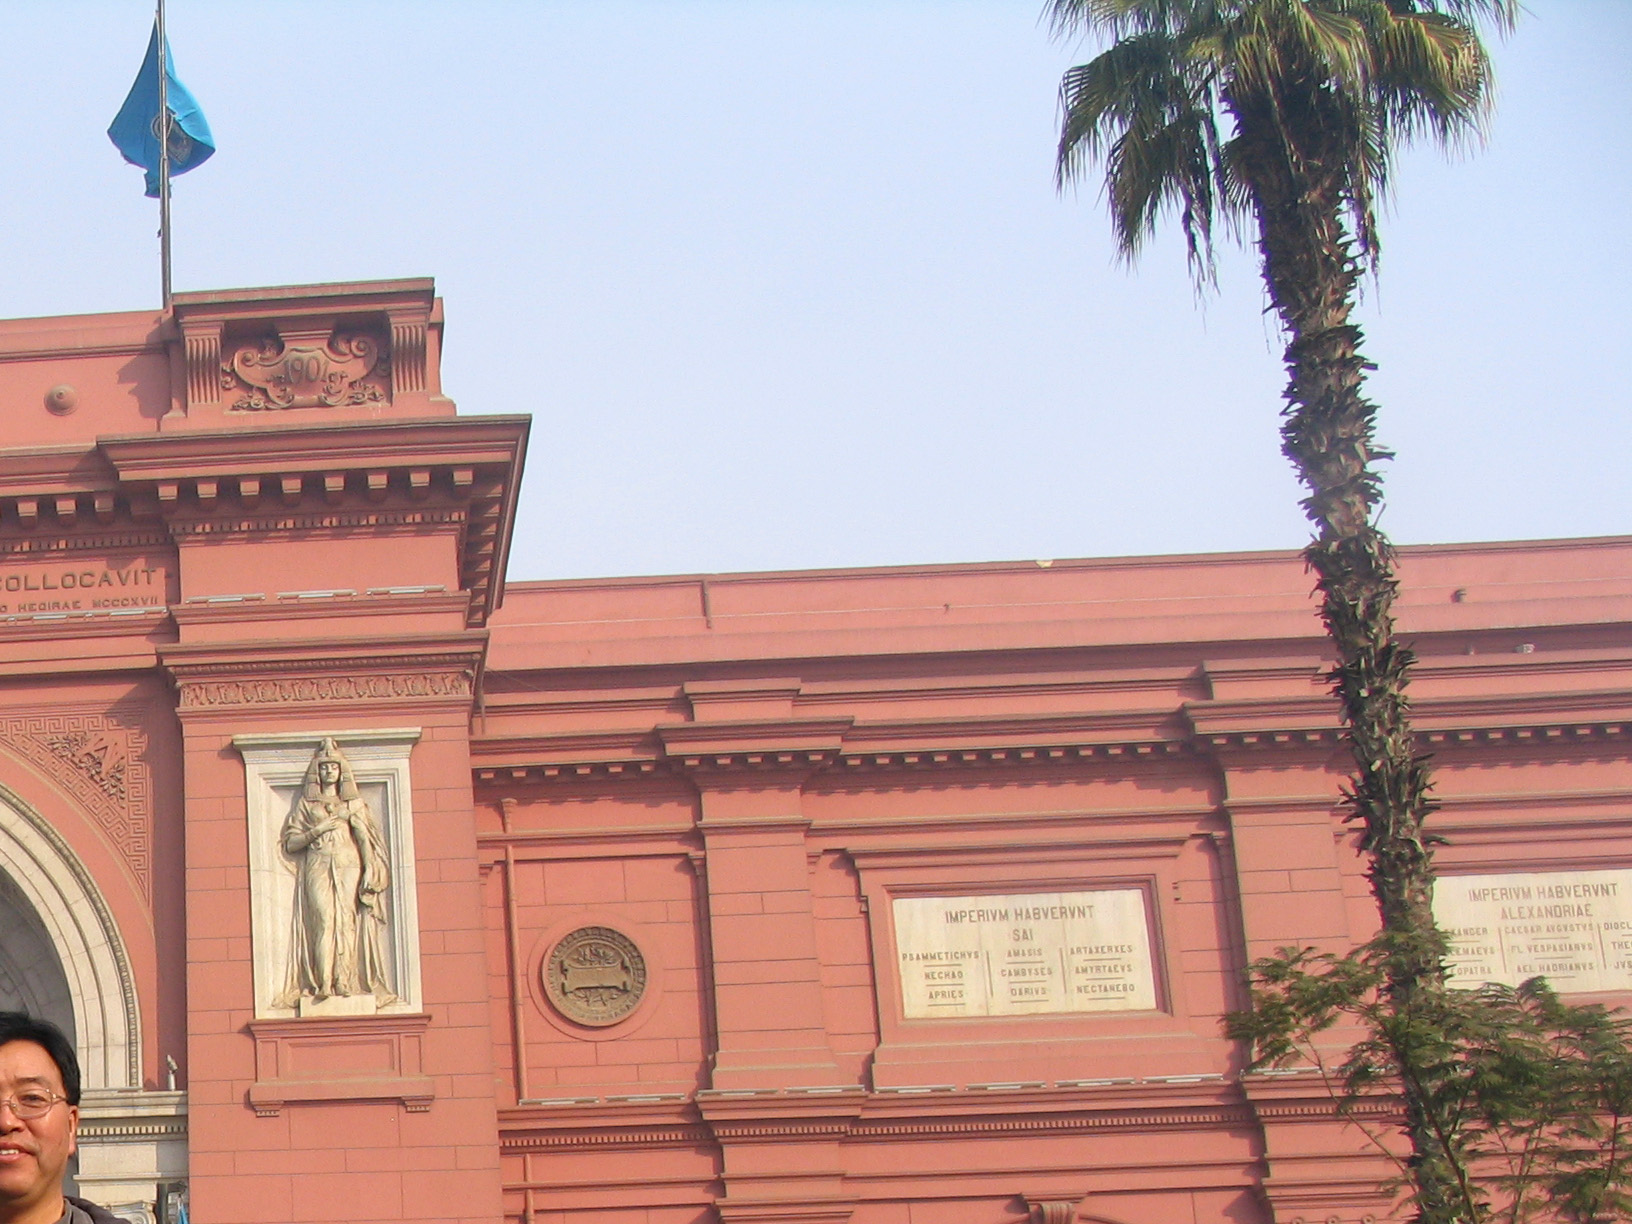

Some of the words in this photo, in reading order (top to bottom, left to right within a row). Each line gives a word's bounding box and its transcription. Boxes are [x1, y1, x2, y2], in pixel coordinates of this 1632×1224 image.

[1468, 886, 1532, 902] IMPERIVM
[1536, 882, 1618, 900] HABVERVNT
[945, 908, 1009, 924] IMPERIVM
[1014, 905, 1094, 921] HABVERVNT
[1500, 903, 1594, 920] ALEXANDRIAE
[1012, 928, 1034, 942] SAI
